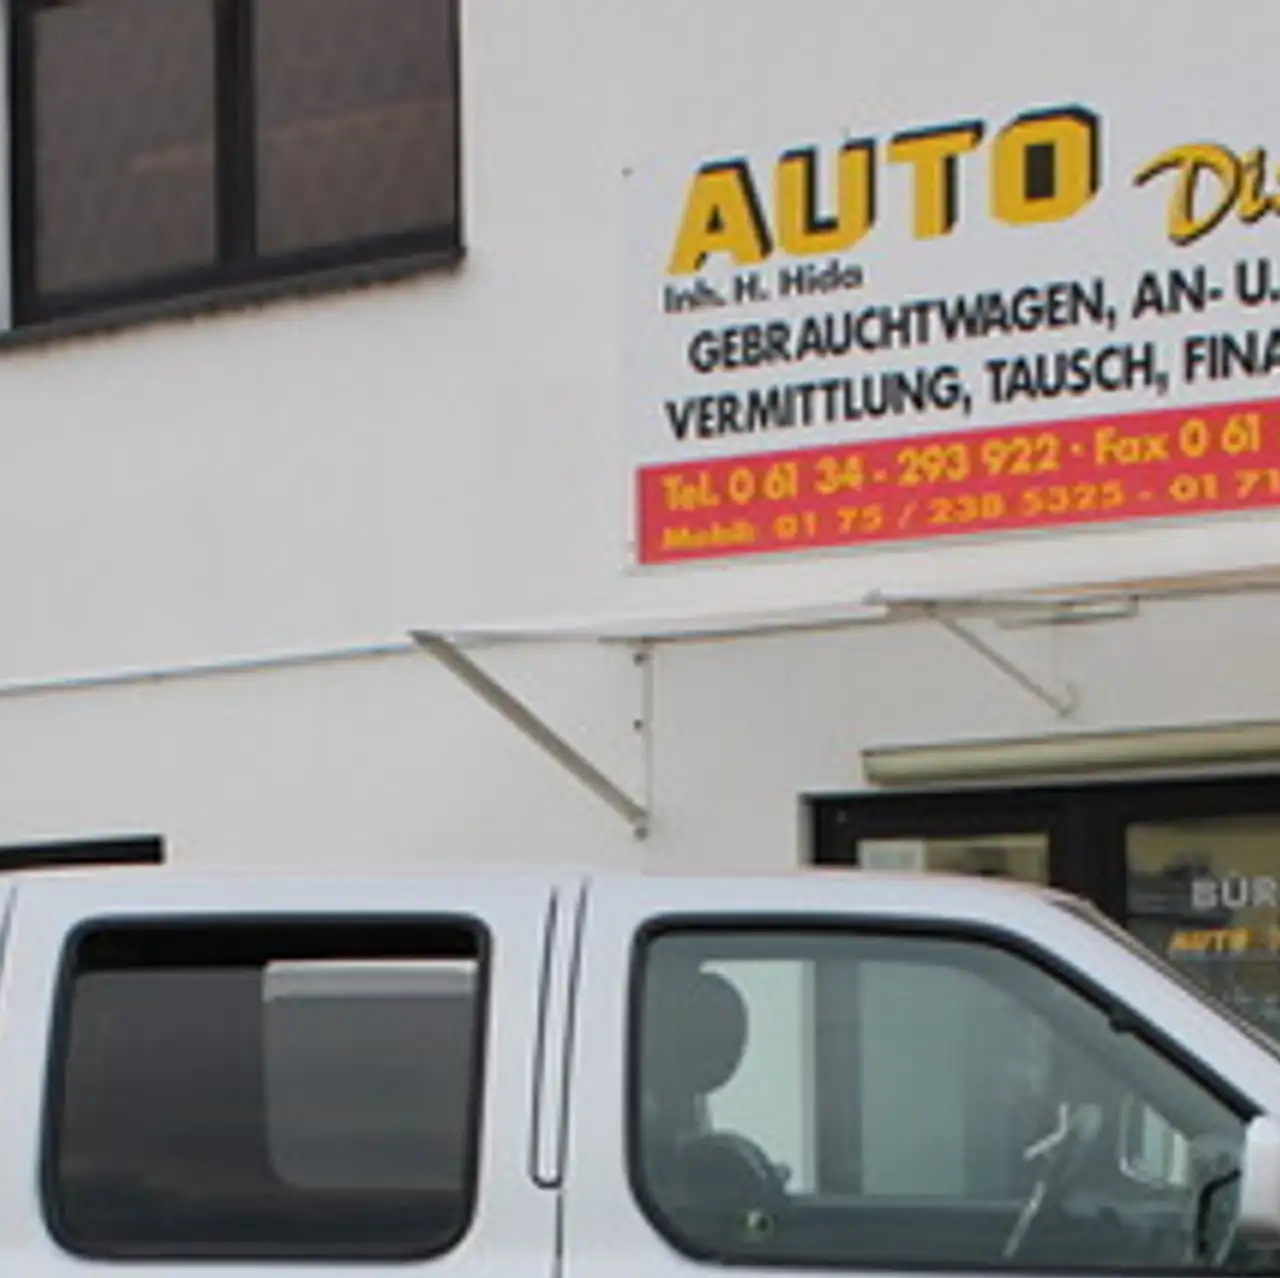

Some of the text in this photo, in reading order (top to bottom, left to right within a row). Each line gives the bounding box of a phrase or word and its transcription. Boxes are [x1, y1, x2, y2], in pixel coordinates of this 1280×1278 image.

[667, 101, 1102, 274] AUTO
[688, 277, 1117, 373] GEBRAUCHTWAGEN,
[1131, 265, 1223, 319] AN-
[734, 272, 769, 304] H.
[664, 365, 972, 441] VERMITTLUNG,
[984, 342, 1170, 402] TAUSCH,
[728, 467, 755, 503] 0
[813, 455, 864, 495] 34
[897, 443, 969, 487] 293
[981, 433, 1060, 477] 922
[1095, 427, 1171, 465] Fax
[1179, 419, 1208, 458] 0
